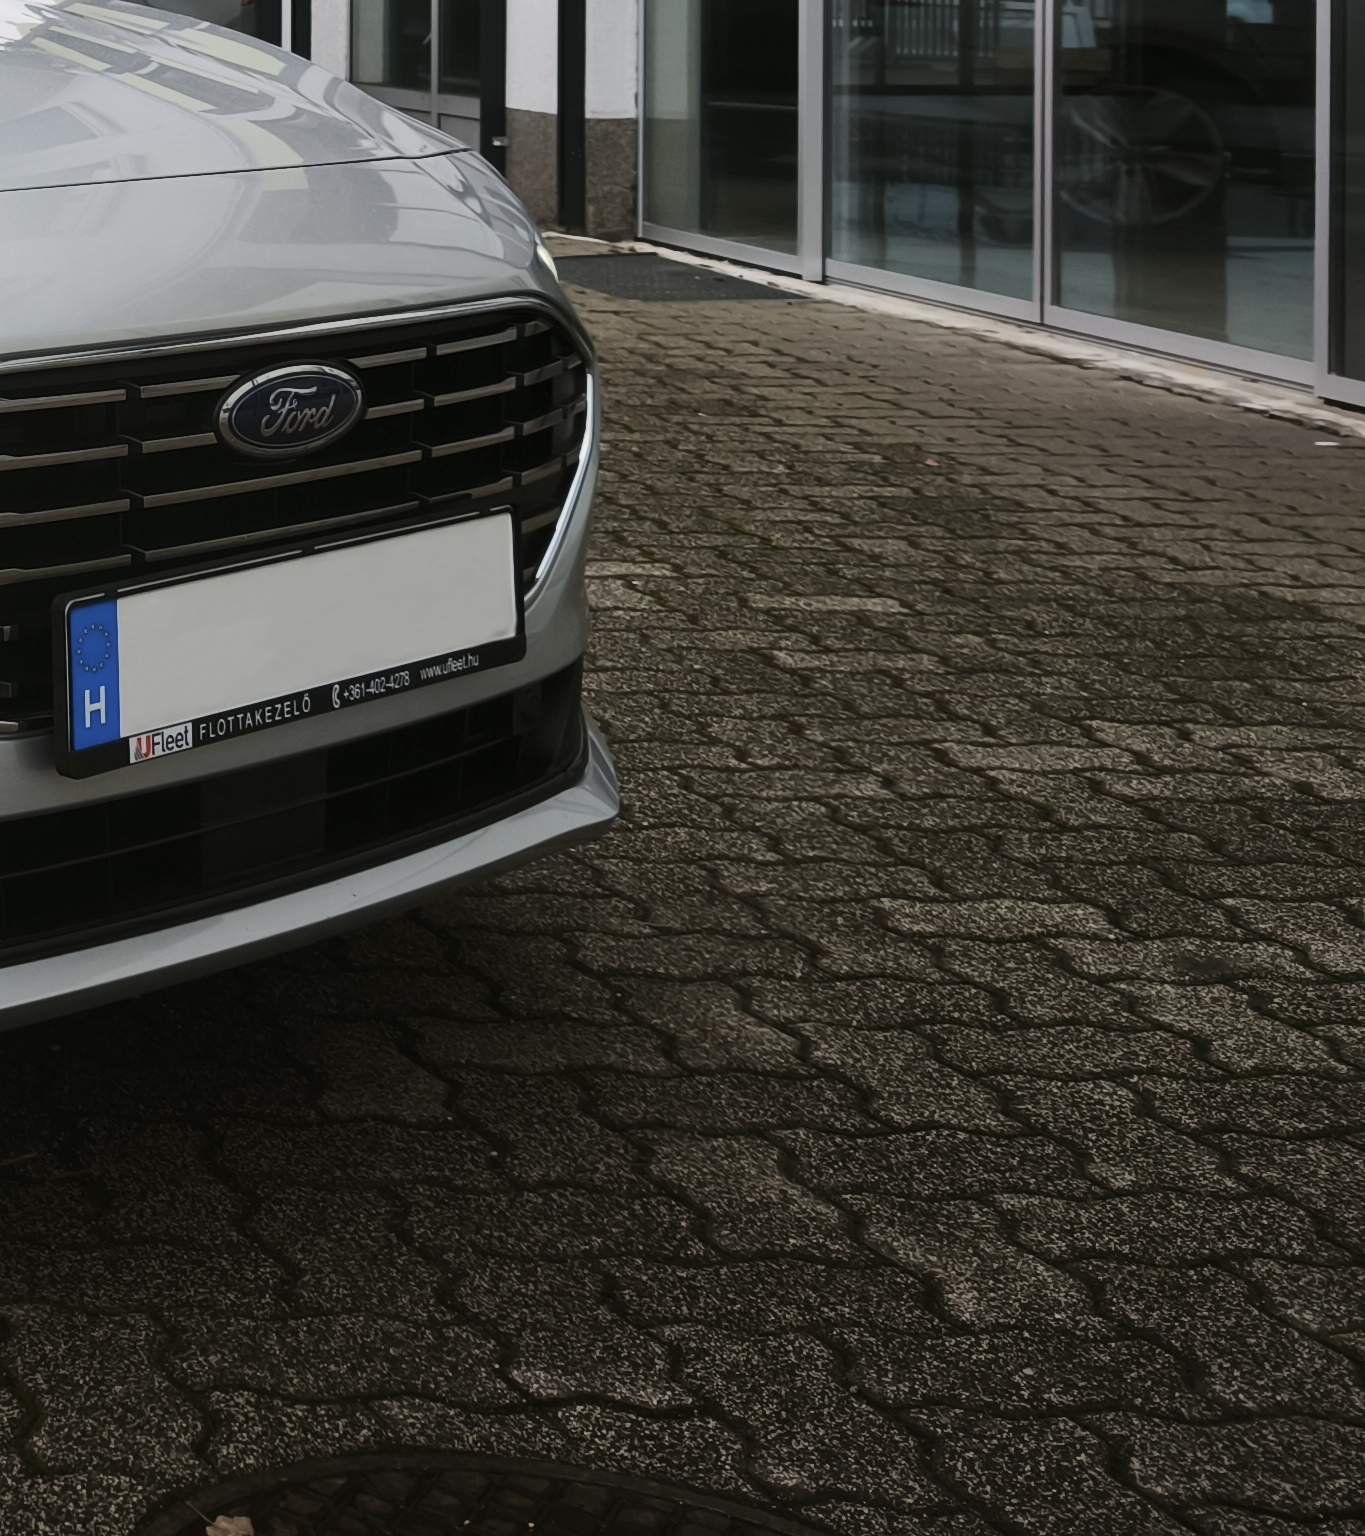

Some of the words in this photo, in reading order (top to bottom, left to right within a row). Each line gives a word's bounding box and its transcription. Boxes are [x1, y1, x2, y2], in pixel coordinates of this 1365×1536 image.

[260, 385, 337, 438] Ford
[84, 685, 107, 729] H
[199, 692, 312, 741] FLOTTAKEZELŐ
[343, 671, 410, 702] +361-402-4278
[419, 653, 480, 681] www.ufleet.hu
